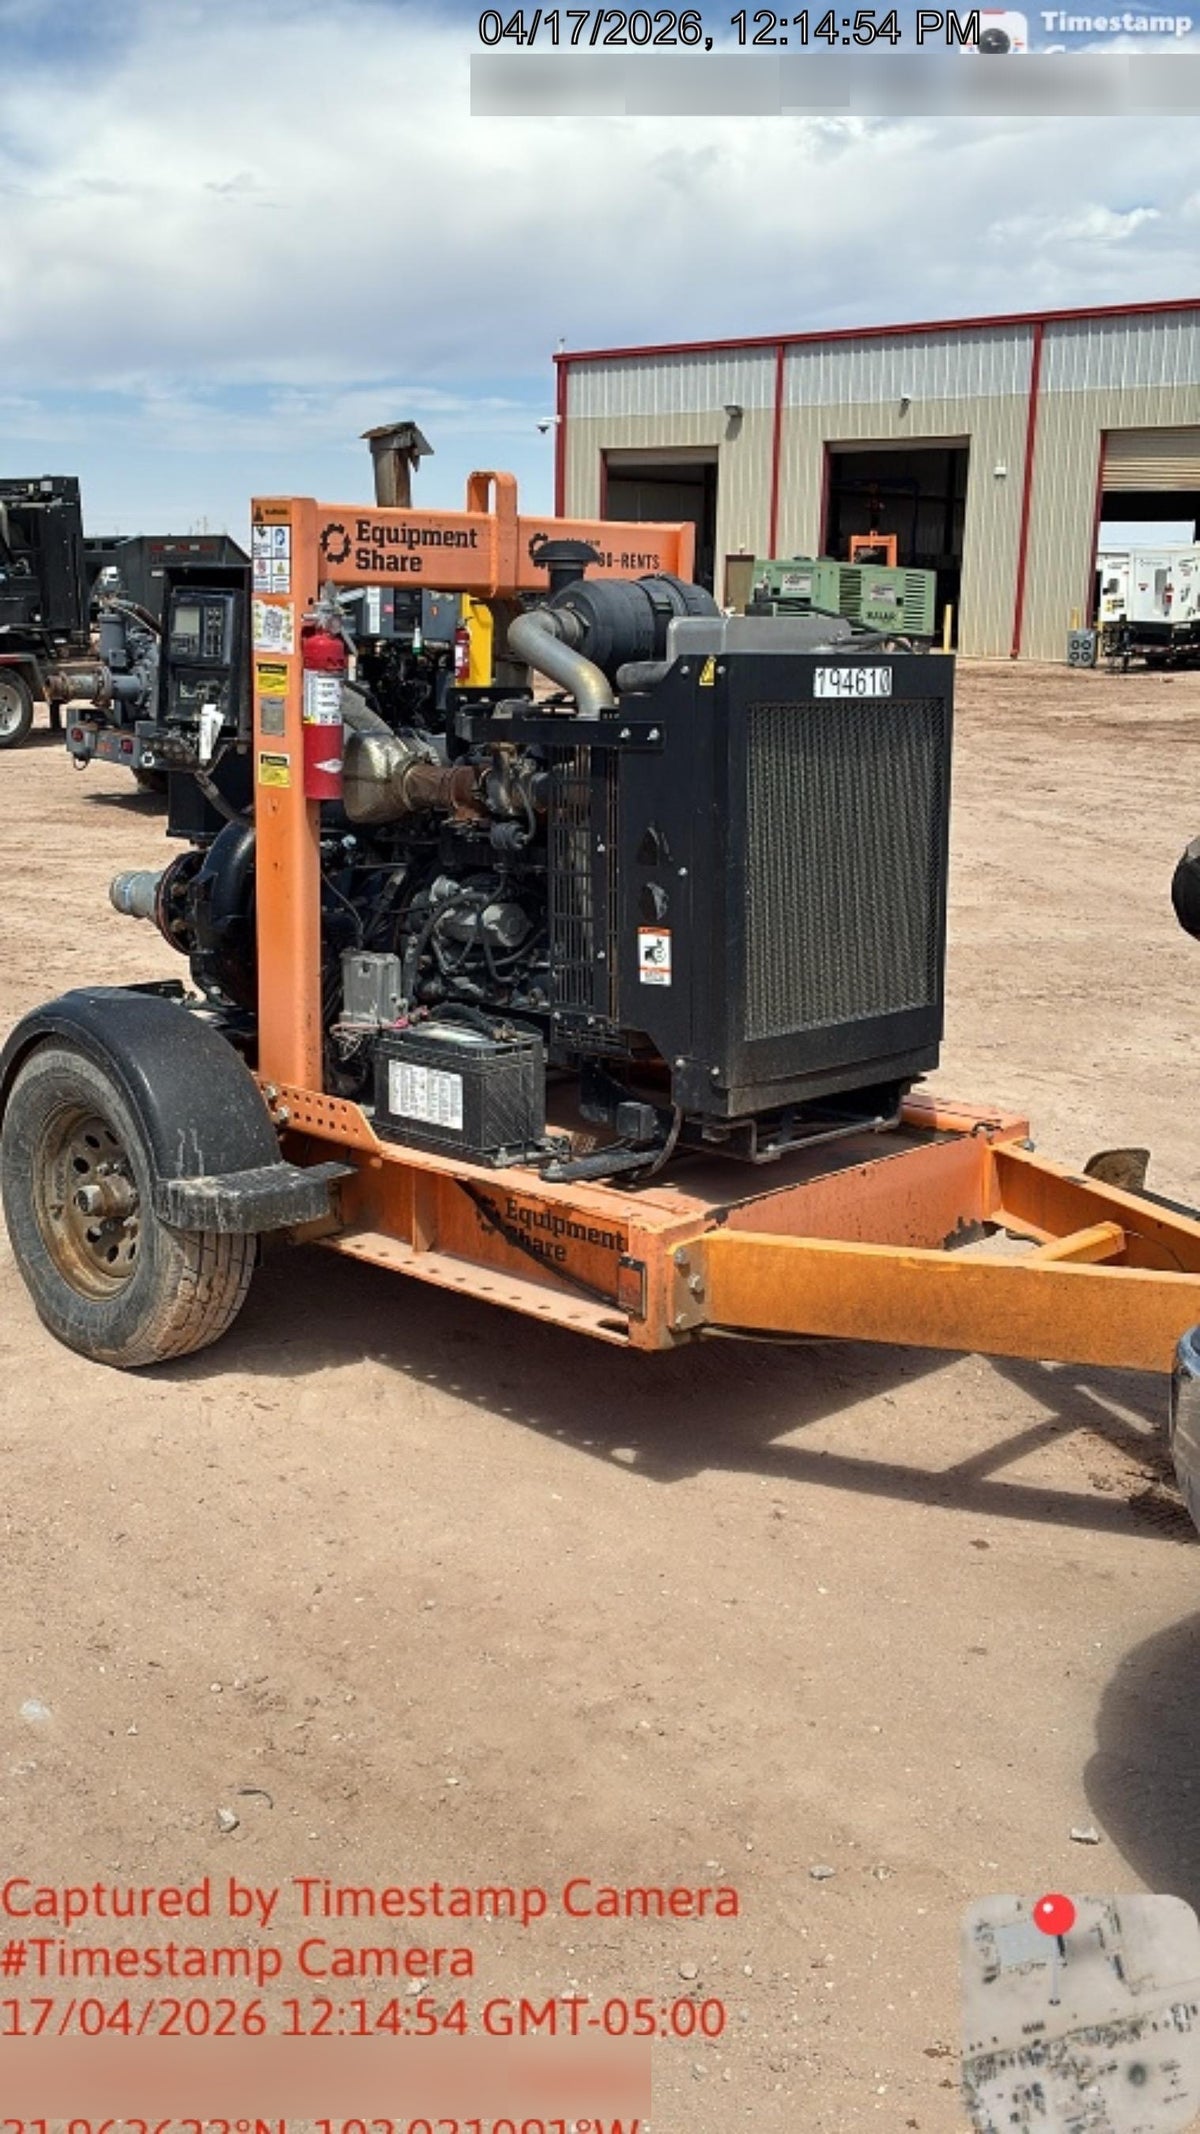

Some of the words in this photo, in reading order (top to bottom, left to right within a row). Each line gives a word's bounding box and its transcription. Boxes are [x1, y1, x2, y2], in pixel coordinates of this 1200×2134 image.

[355, 519, 478, 550] Equipment
[355, 548, 423, 572] Share
[817, 667, 890, 695] 194610
[505, 1197, 626, 1252] Equipment
